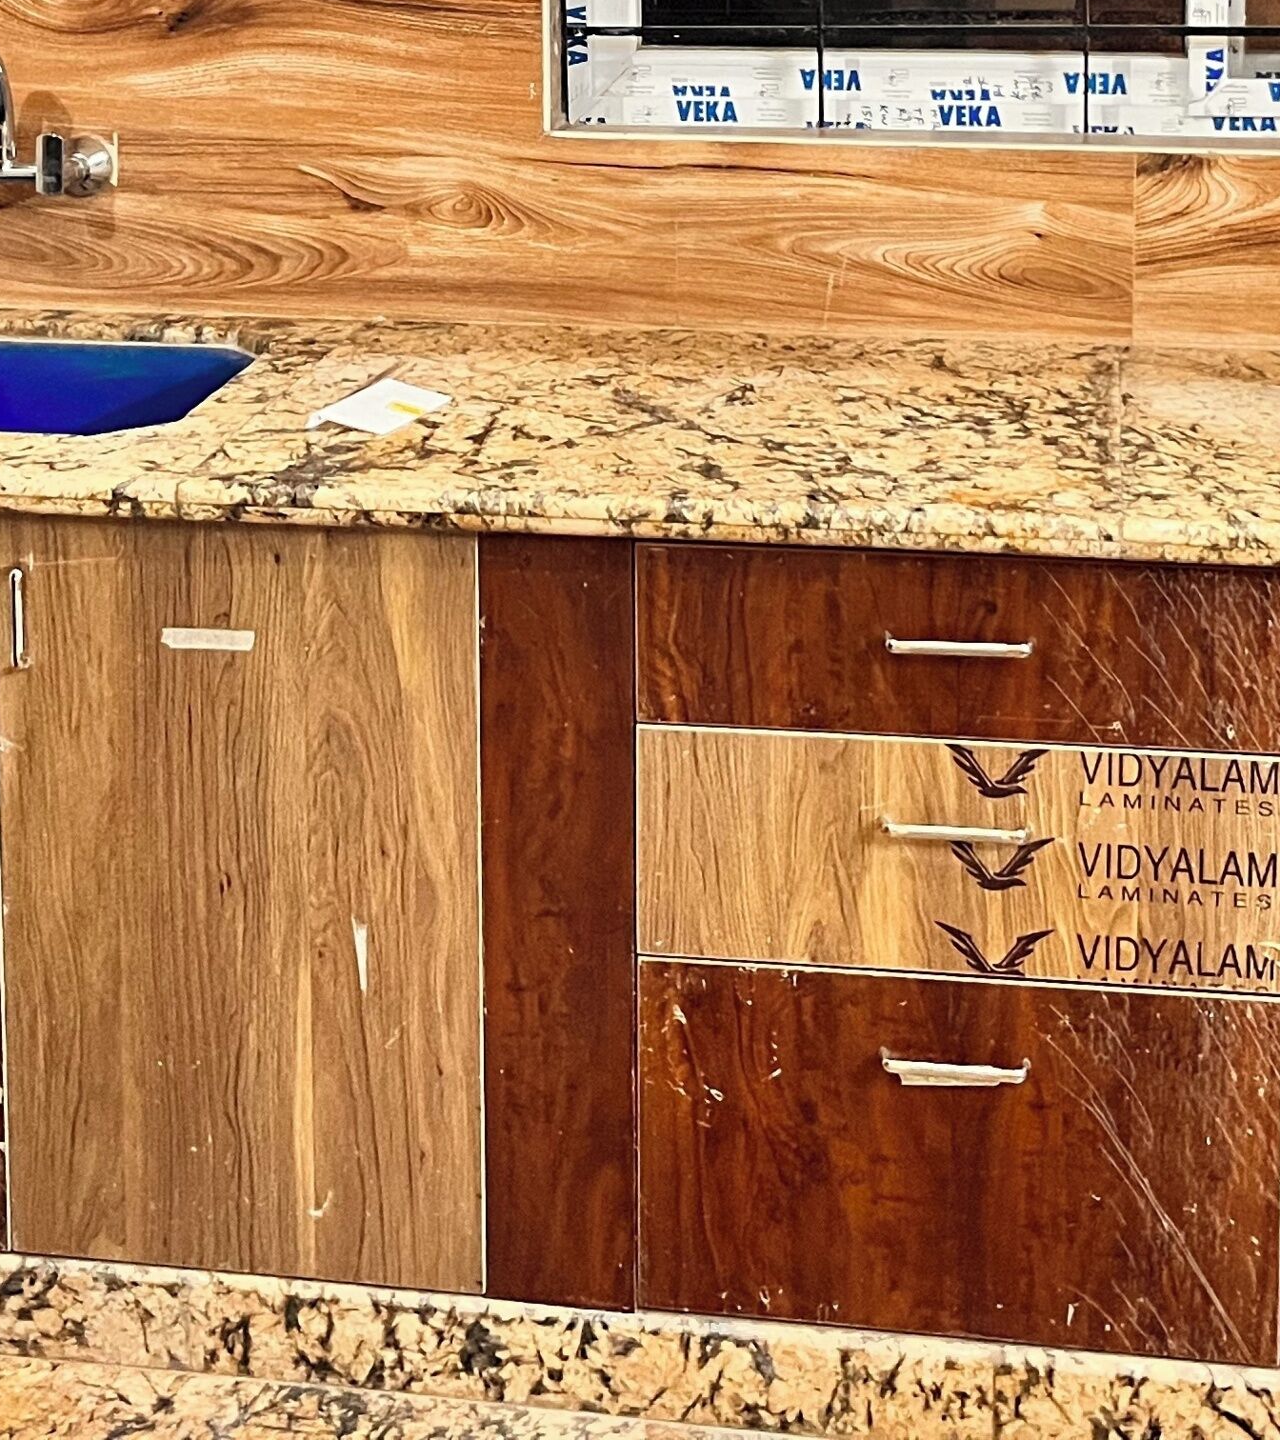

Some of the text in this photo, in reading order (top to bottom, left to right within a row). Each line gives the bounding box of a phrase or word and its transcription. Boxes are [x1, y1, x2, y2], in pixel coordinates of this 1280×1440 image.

[567, 6, 588, 66] VKA
[676, 100, 738, 122] VEKA
[938, 105, 1002, 127] VEKA
[1212, 116, 1277, 132] VEKA
[1080, 751, 1279, 795] VIDYALAM
[1079, 792, 1274, 817] LAMINATES
[1078, 842, 1277, 888] VIDYALAM
[1078, 884, 1272, 910] LAMINATES
[1077, 933, 1275, 981] VIDYALAM
